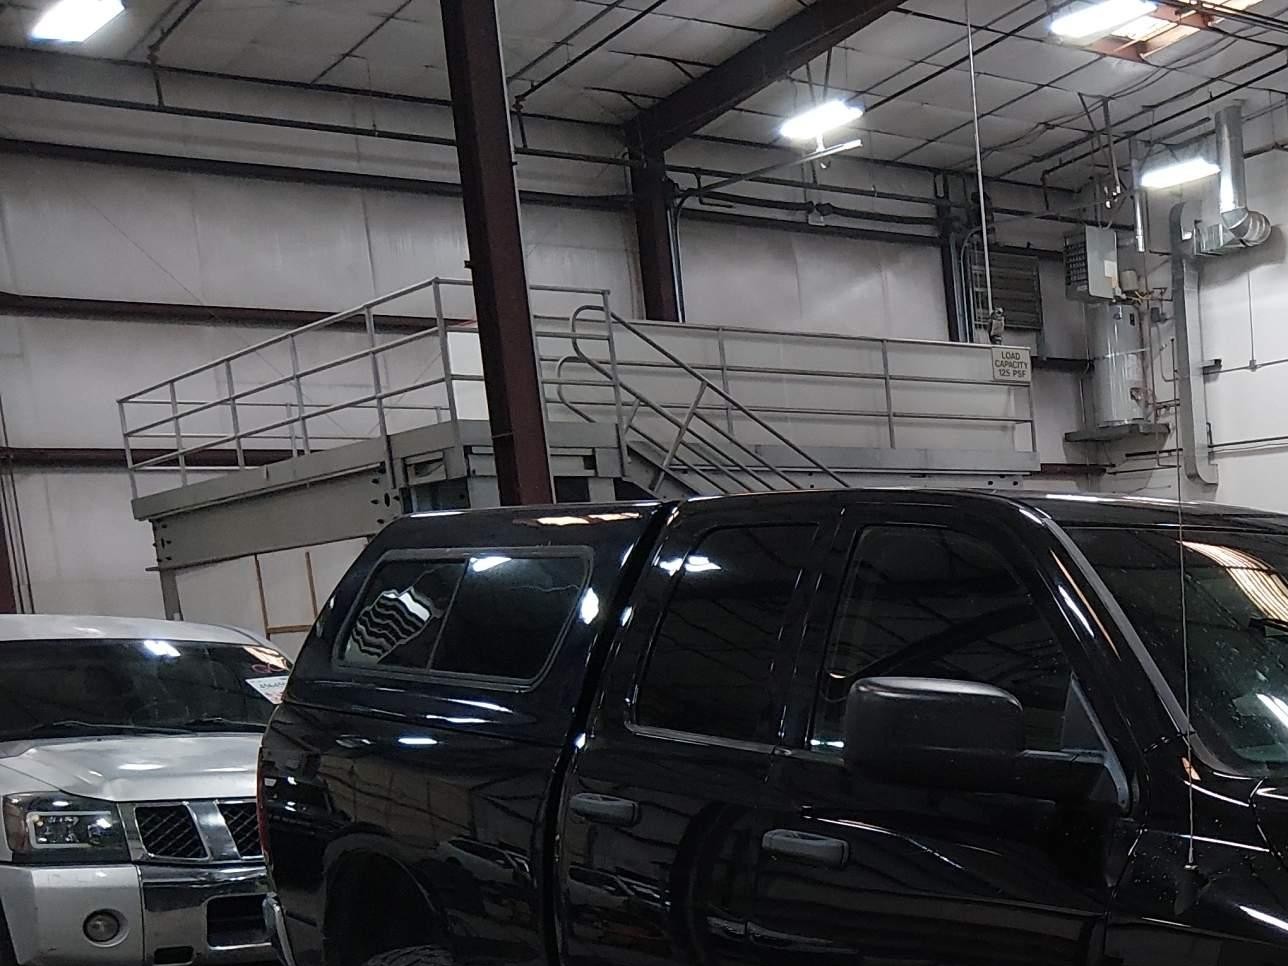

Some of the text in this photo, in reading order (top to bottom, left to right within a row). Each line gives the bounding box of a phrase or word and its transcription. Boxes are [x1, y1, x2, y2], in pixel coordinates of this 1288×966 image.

[1001, 351, 1021, 361] LOAD
[994, 359, 1028, 370] CAPACITY
[999, 368, 1011, 377] 125
